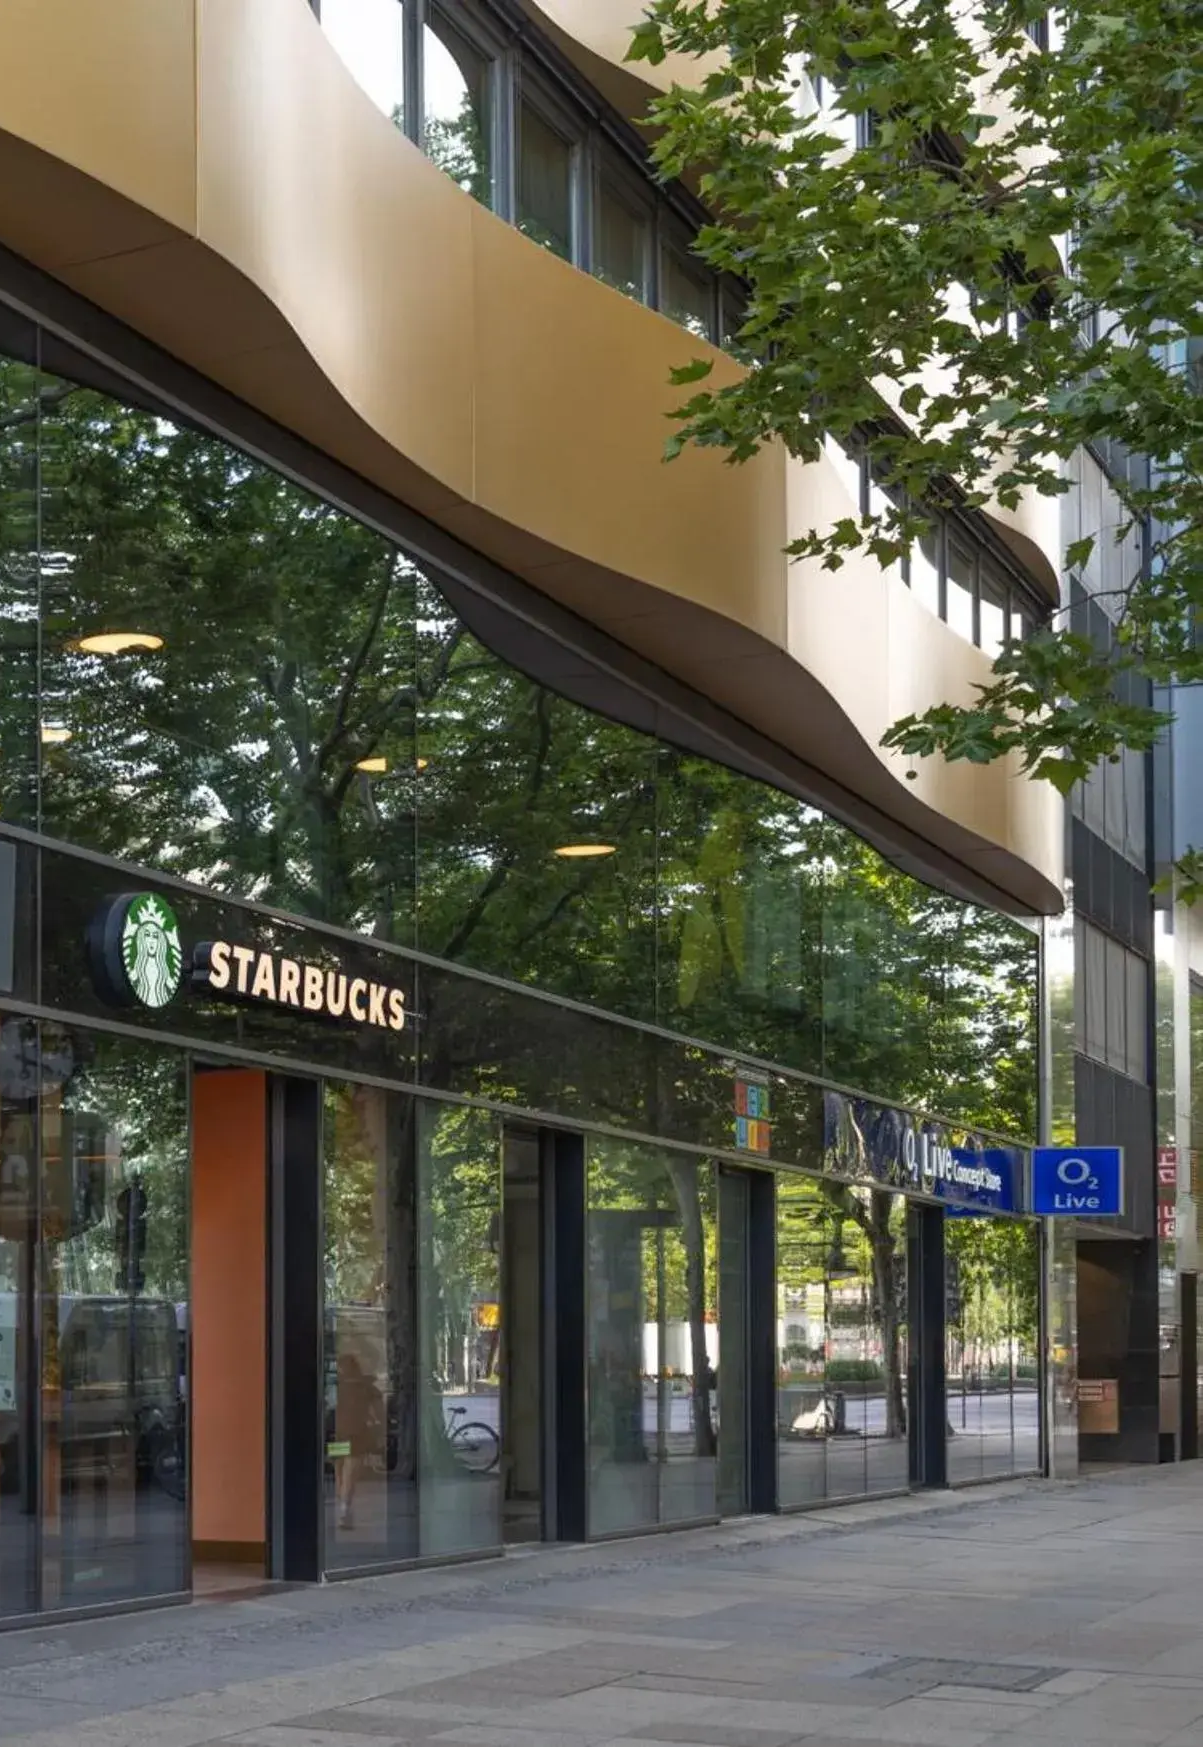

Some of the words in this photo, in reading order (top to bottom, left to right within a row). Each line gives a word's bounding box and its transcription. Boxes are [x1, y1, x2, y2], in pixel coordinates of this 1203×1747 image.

[208, 941, 405, 1031] STARBUCKS
[923, 1133, 952, 1181] Live
[1054, 1193, 1100, 1209] Live
